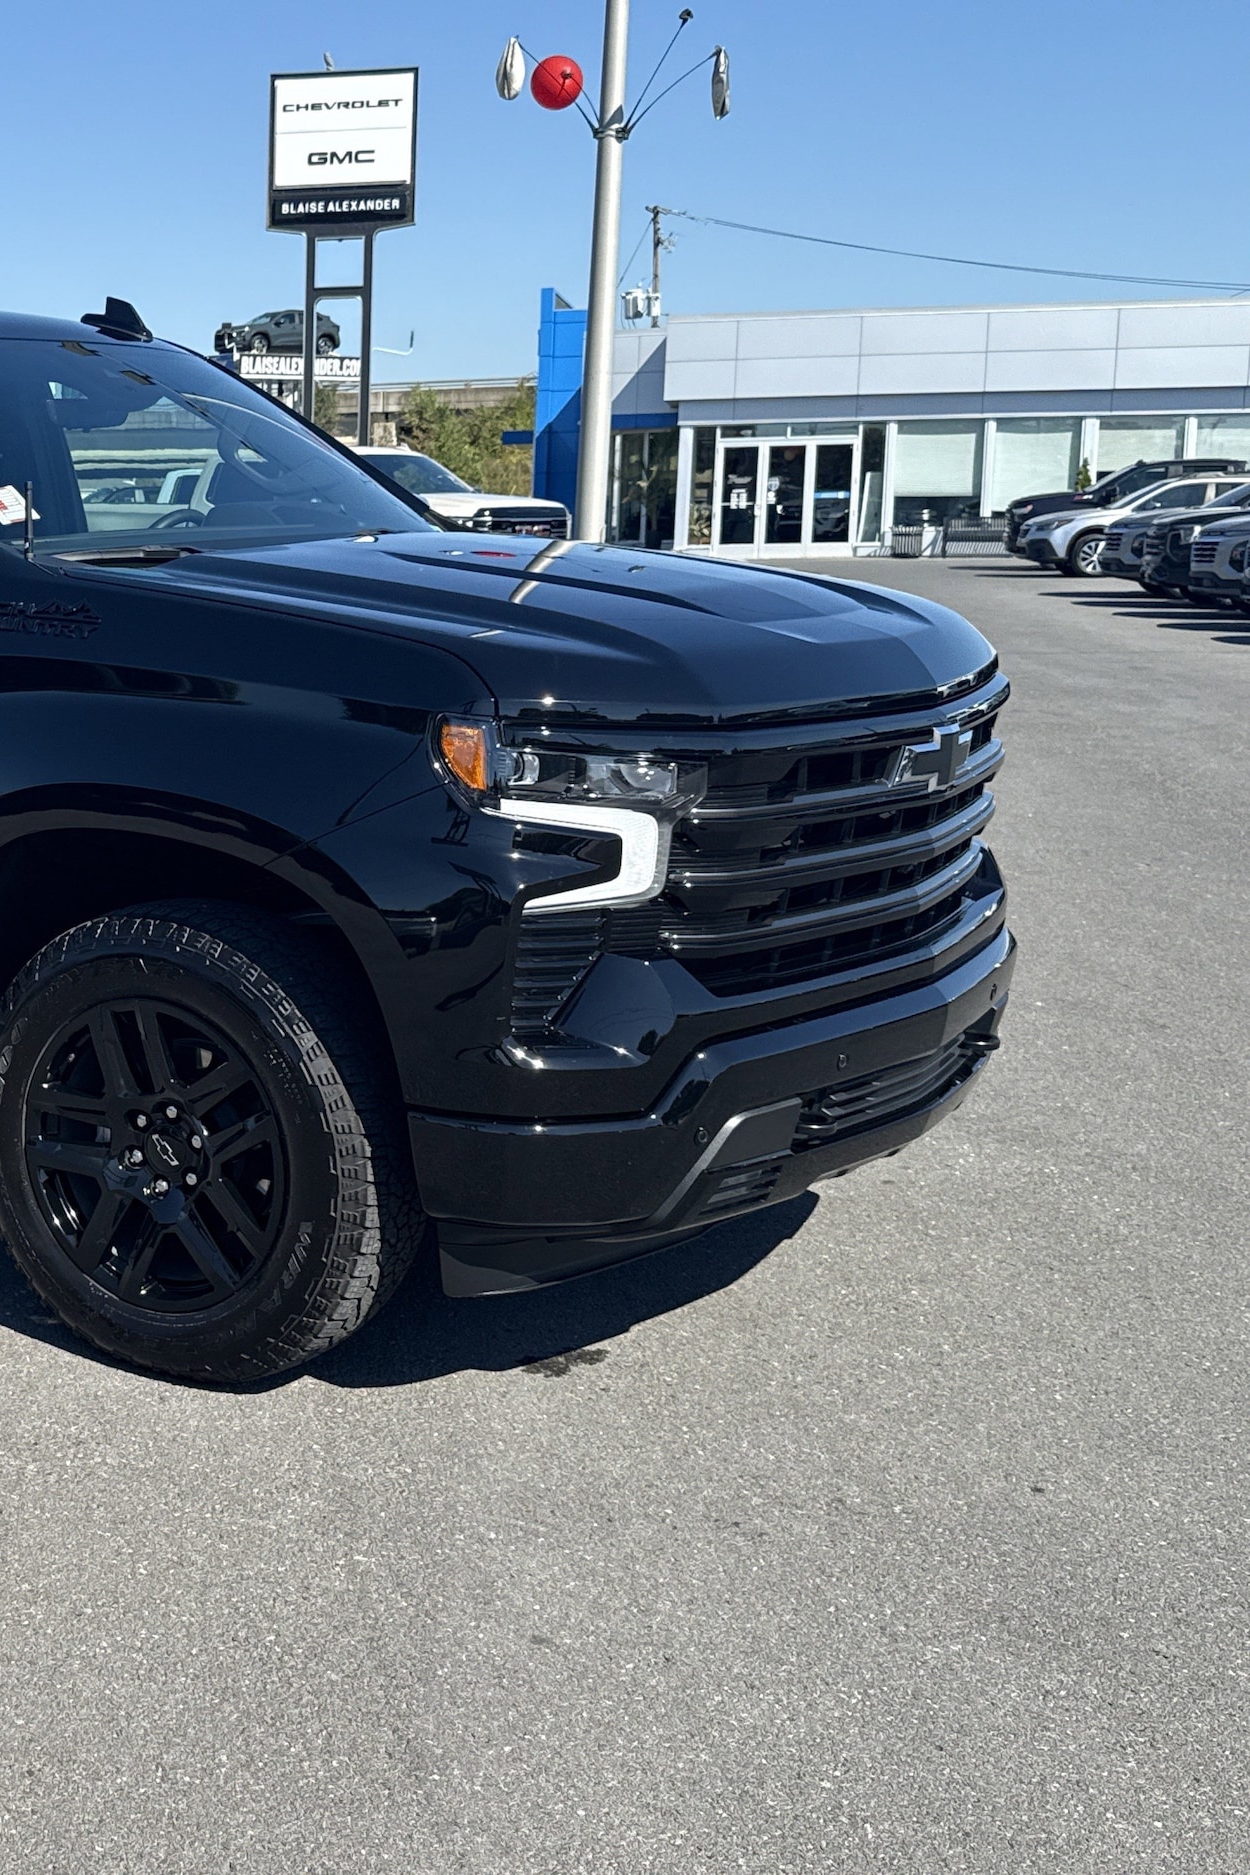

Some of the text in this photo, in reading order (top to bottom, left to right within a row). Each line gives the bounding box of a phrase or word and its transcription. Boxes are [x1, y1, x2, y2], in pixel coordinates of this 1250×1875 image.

[282, 98, 403, 113] CHEVROLET
[307, 149, 376, 166] GMC
[281, 198, 400, 215] BLAISE ALEXANDER
